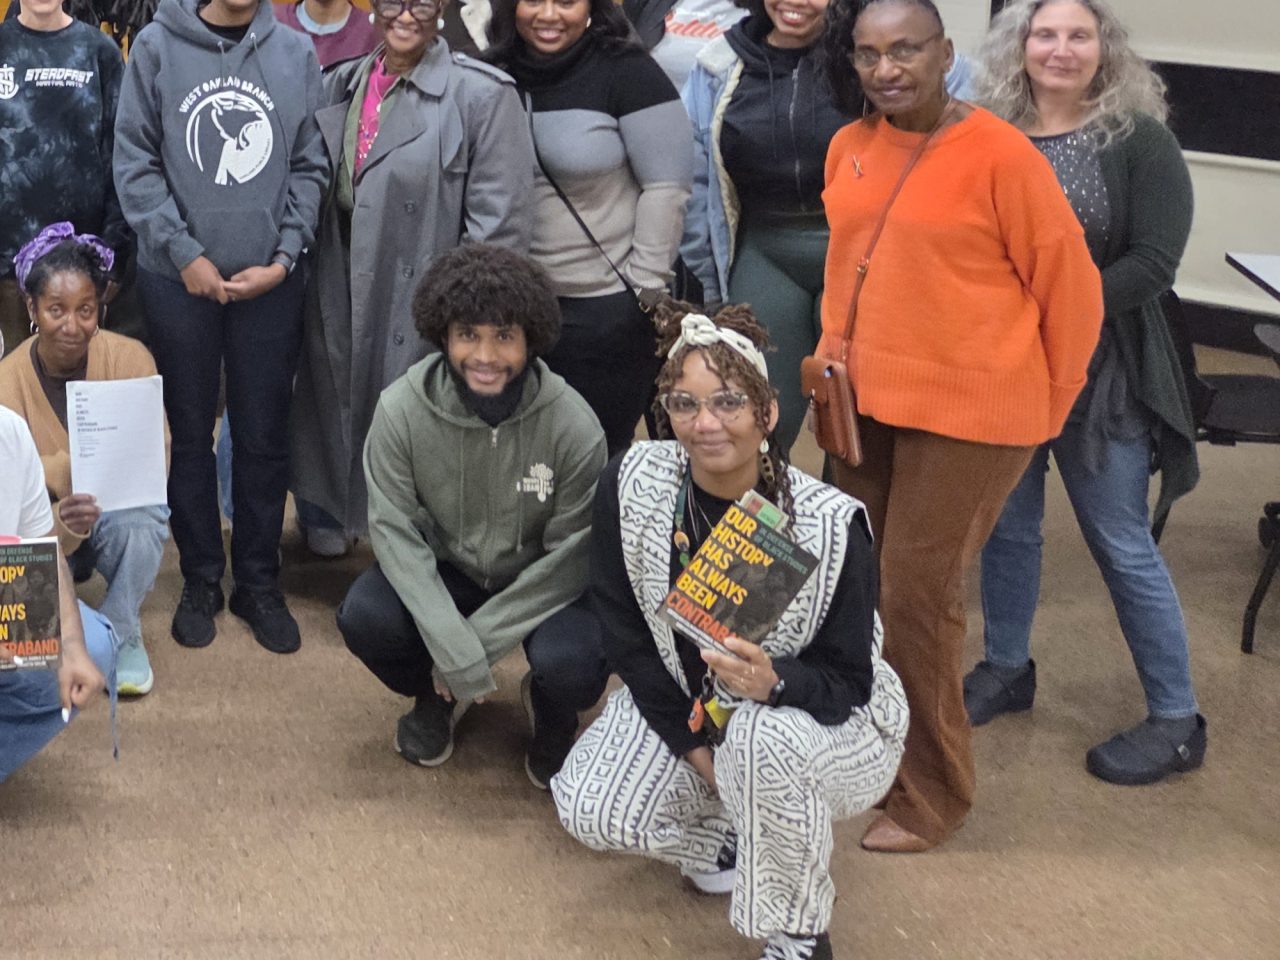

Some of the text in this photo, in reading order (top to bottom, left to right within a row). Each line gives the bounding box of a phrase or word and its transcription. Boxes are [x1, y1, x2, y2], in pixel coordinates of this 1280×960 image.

[179, 86, 201, 113] WEST
[241, 80, 275, 111] BRANCH
[725, 506, 757, 537] OUR
[699, 540, 733, 570] HAS
[711, 523, 774, 567] HISTORY
[676, 574, 718, 609] BEEN
[689, 558, 748, 605] ALWAYS
